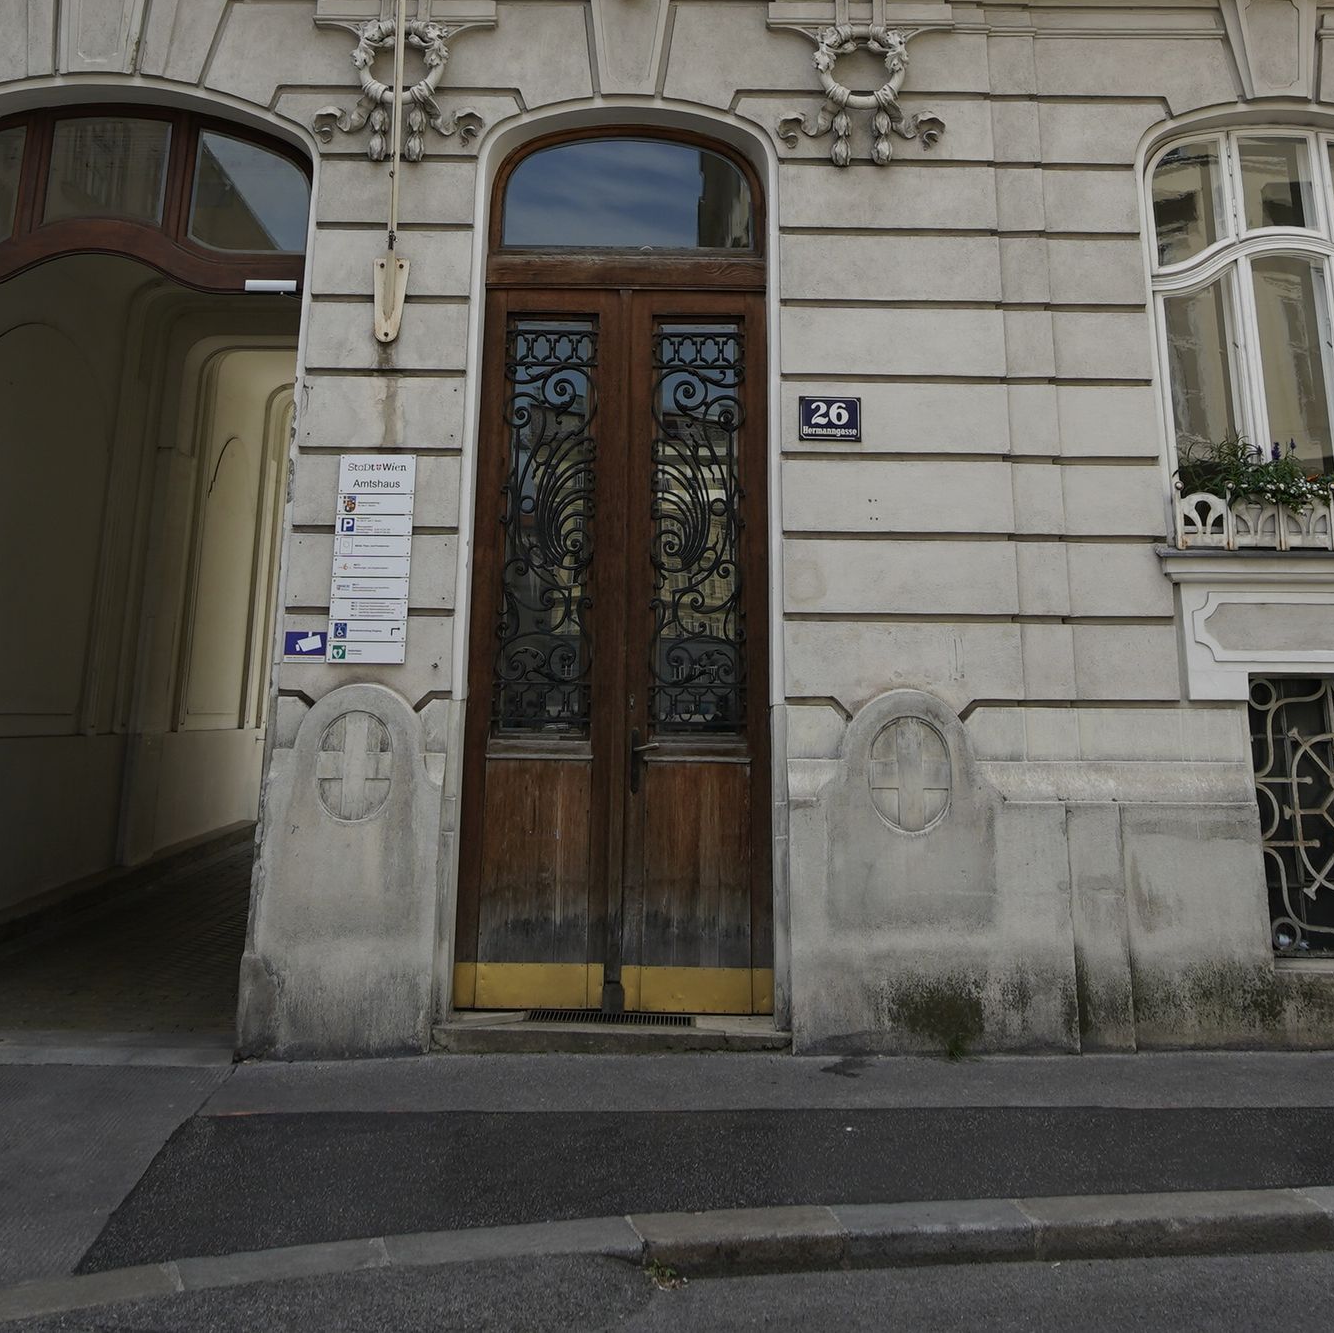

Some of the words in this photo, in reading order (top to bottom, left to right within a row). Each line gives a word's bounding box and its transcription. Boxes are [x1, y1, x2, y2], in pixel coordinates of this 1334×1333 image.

[810, 401, 849, 425] 26
[802, 425, 858, 437] Hermanngasse
[382, 462, 407, 472] Wien
[352, 479, 401, 489] Amtshaus
